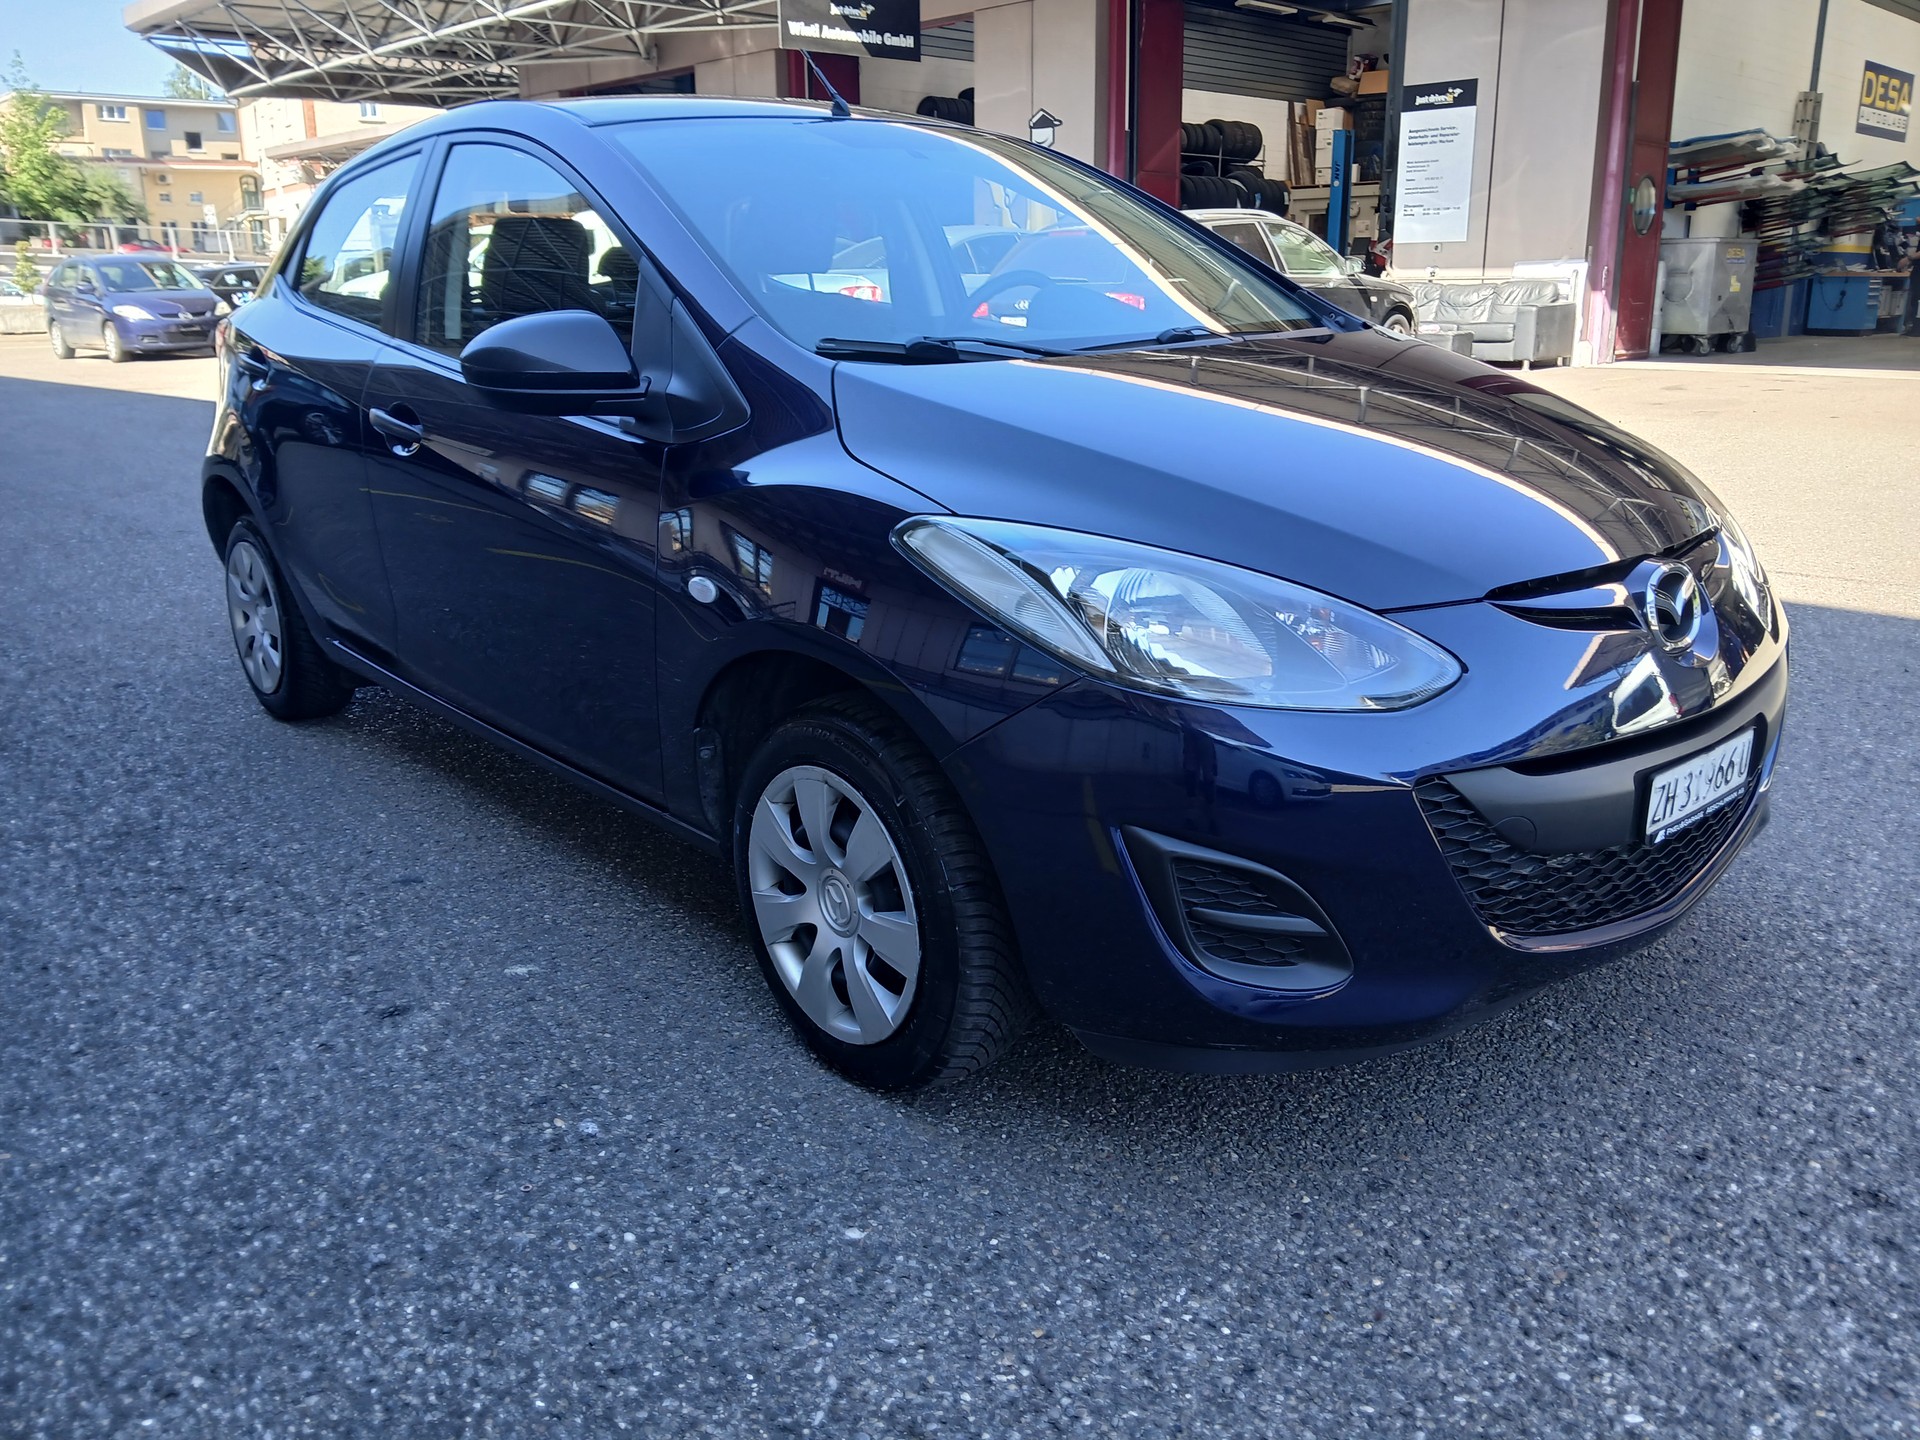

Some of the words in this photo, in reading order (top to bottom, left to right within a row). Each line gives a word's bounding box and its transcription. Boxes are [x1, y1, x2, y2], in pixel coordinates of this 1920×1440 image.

[787, 20, 821, 38] Winti
[821, 25, 882, 45] Automobile
[883, 32, 914, 48] GmbH
[1861, 70, 1911, 112] DESA
[1652, 777, 1679, 825] ZH
